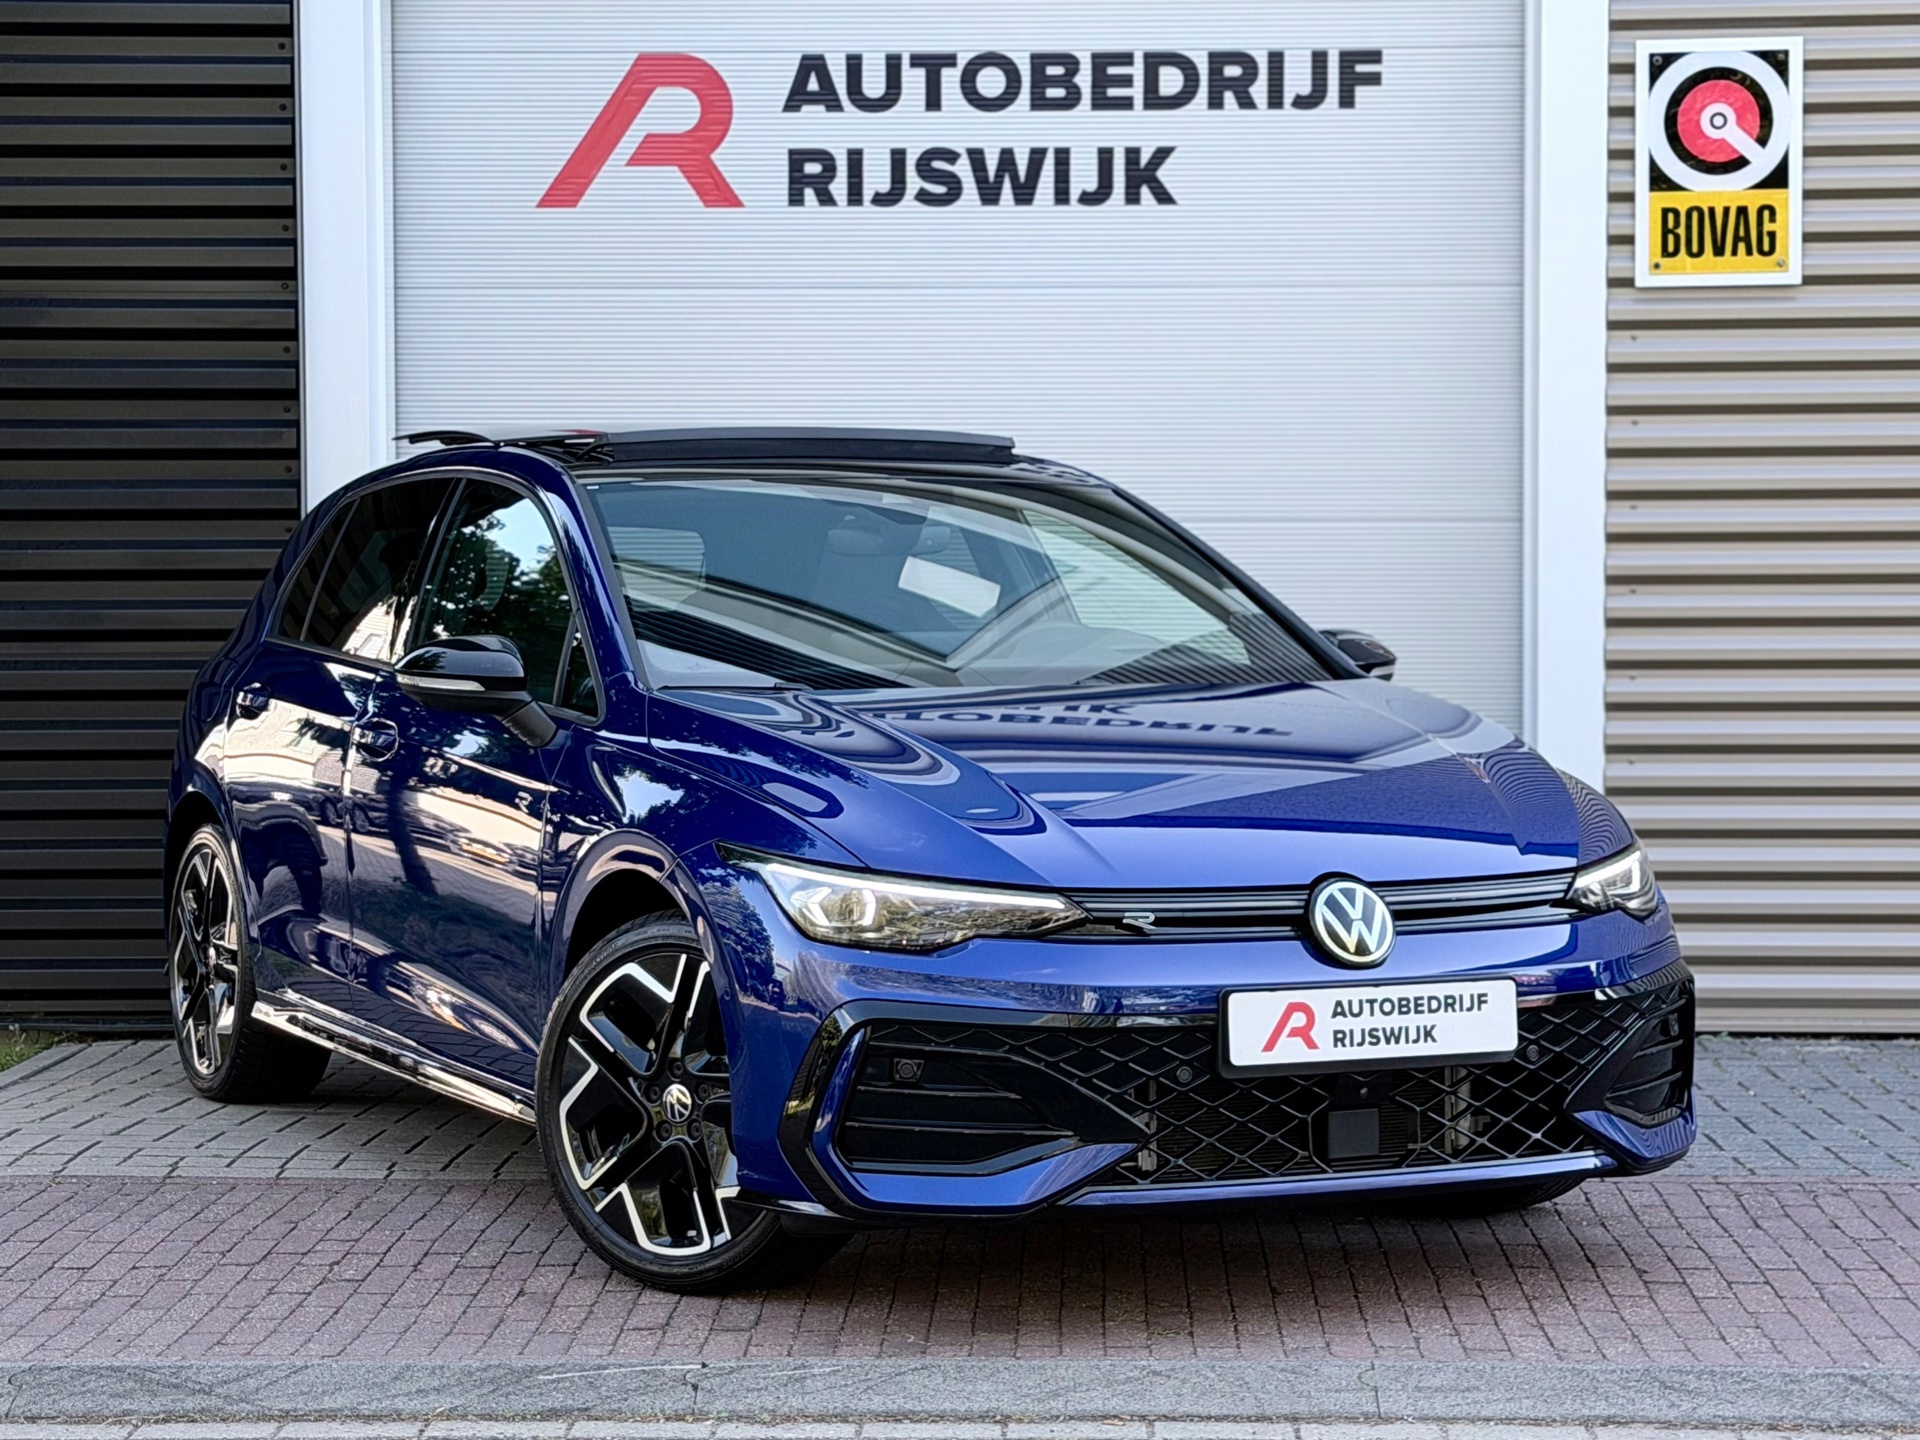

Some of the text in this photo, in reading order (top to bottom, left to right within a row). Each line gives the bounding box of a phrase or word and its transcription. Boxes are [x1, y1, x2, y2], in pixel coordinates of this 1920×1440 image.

[783, 50, 1382, 112] AUTOBEDRIJF
[788, 147, 1177, 207] RIJSWIJK
[1661, 204, 1777, 258] BOVAG
[1331, 993, 1489, 1019] AUTOBEDRIJF
[1332, 1024, 1438, 1048] RIJSWIJK
